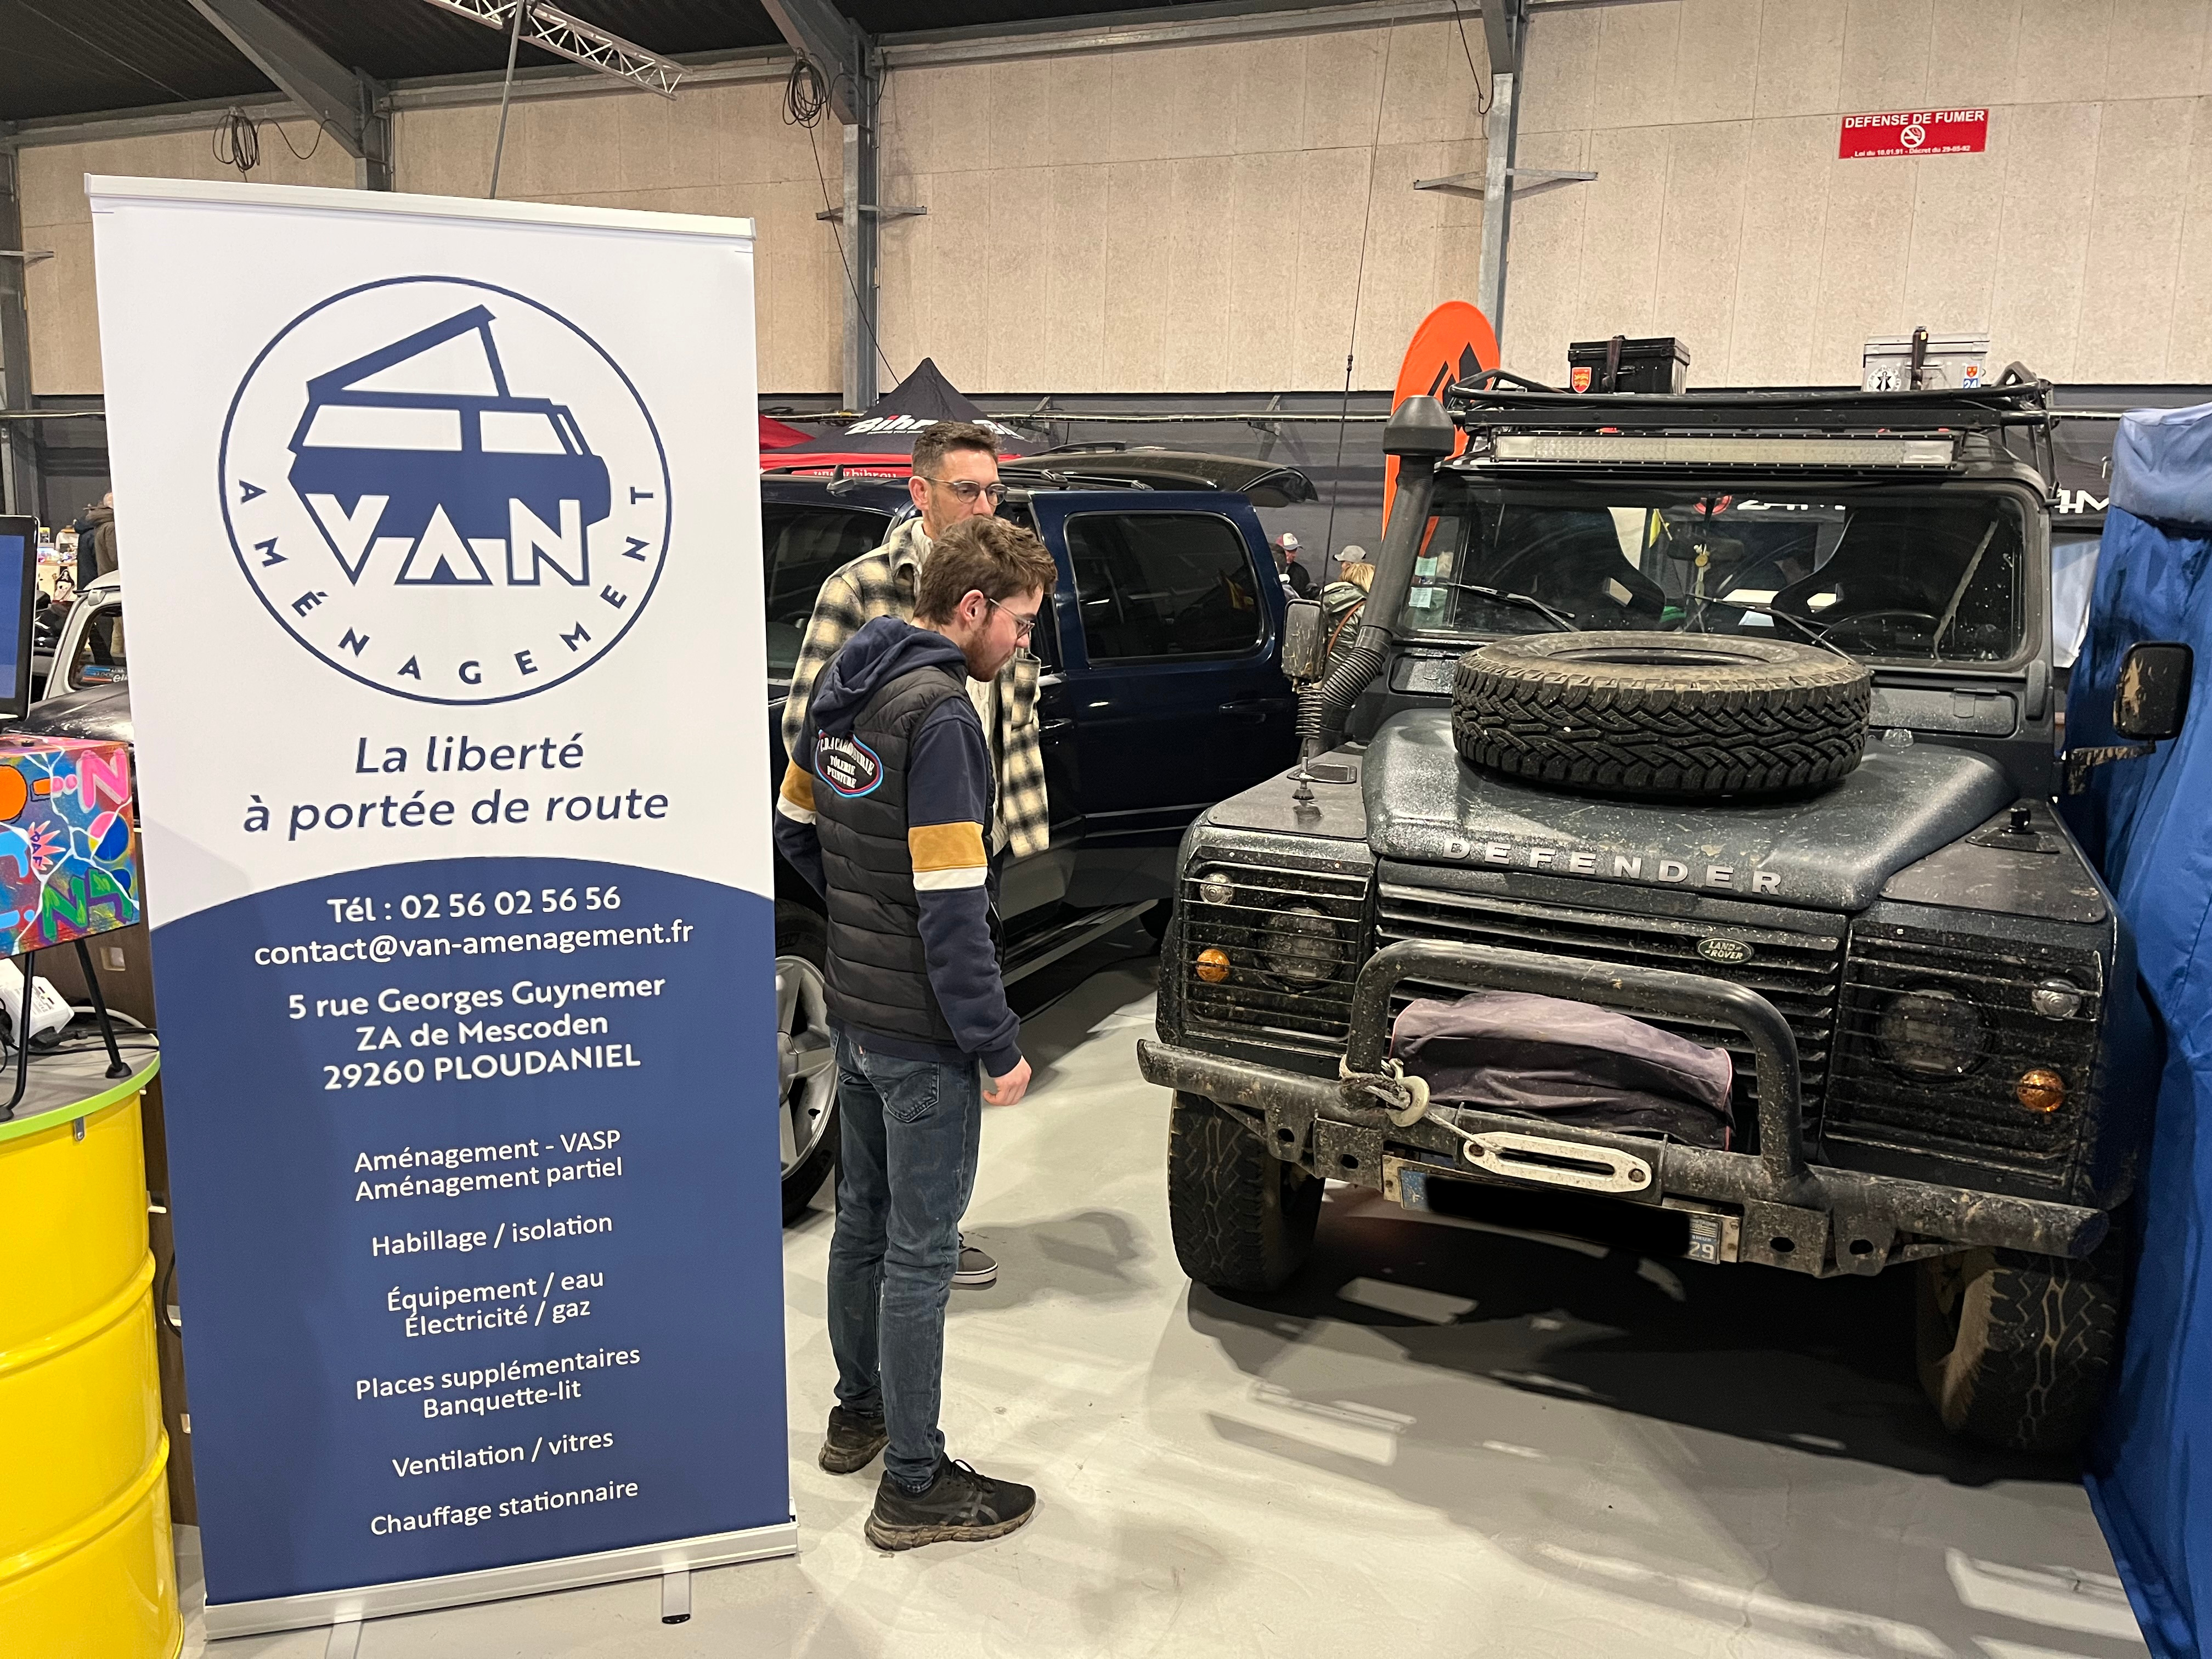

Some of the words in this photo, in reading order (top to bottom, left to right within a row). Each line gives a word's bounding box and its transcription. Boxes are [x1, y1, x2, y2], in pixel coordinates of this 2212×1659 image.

[1845, 114, 1909, 128] DEFENSE
[1912, 113, 1932, 125] DE
[1935, 110, 1985, 123] FUMER
[1964, 380, 1978, 388] 24
[302, 493, 590, 586] VAN
[238, 479, 655, 686] AMÉNAGEMENT
[356, 737, 407, 774] La
[426, 732, 584, 772] liberté
[244, 794, 269, 832] à
[288, 790, 455, 842] portée
[471, 788, 529, 825] de
[546, 789, 668, 821] route
[1442, 837, 1782, 895] DEFENDER
[326, 896, 376, 923] Tél
[384, 902, 392, 921] :
[400, 893, 441, 919] 02
[449, 893, 486, 917] 56
[494, 889, 533, 915] 02
[541, 888, 577, 912] 56
[586, 886, 621, 910] 56
[255, 918, 694, 966] contact@van-amenagement.fr
[289, 994, 307, 1019] 5
[317, 997, 369, 1017] rue
[378, 988, 504, 1015] Georges
[512, 978, 666, 1008] Guynemer
[356, 1025, 402, 1051] ZA
[410, 1022, 449, 1047] de
[458, 1013, 608, 1045] Mescoden
[323, 1059, 425, 1090] 29260
[435, 1043, 641, 1081] PLOUDANIEL
[354, 1139, 539, 1173] Aménagement
[560, 1130, 620, 1153] VASP
[355, 1167, 540, 1201] Aménagement
[547, 1156, 622, 1187] partiel
[373, 1229, 487, 1257] Habillage
[493, 1223, 505, 1249] /
[512, 1215, 612, 1243] isolation
[1688, 1241, 1714, 1260] 29
[387, 1278, 537, 1310] Équipement
[543, 1272, 555, 1298] /
[561, 1272, 603, 1291] eau
[405, 1305, 528, 1338] Électricité
[534, 1300, 546, 1327] /
[552, 1301, 591, 1324] gaz
[357, 1375, 435, 1400] Places
[441, 1348, 640, 1389] supplémentaires
[424, 1380, 582, 1418] Banquette-lit
[392, 1445, 524, 1477] Ventilation
[531, 1437, 543, 1463] /
[548, 1432, 613, 1455] vitres
[371, 1505, 492, 1535] Chauffage
[499, 1481, 638, 1517] stationnaire
